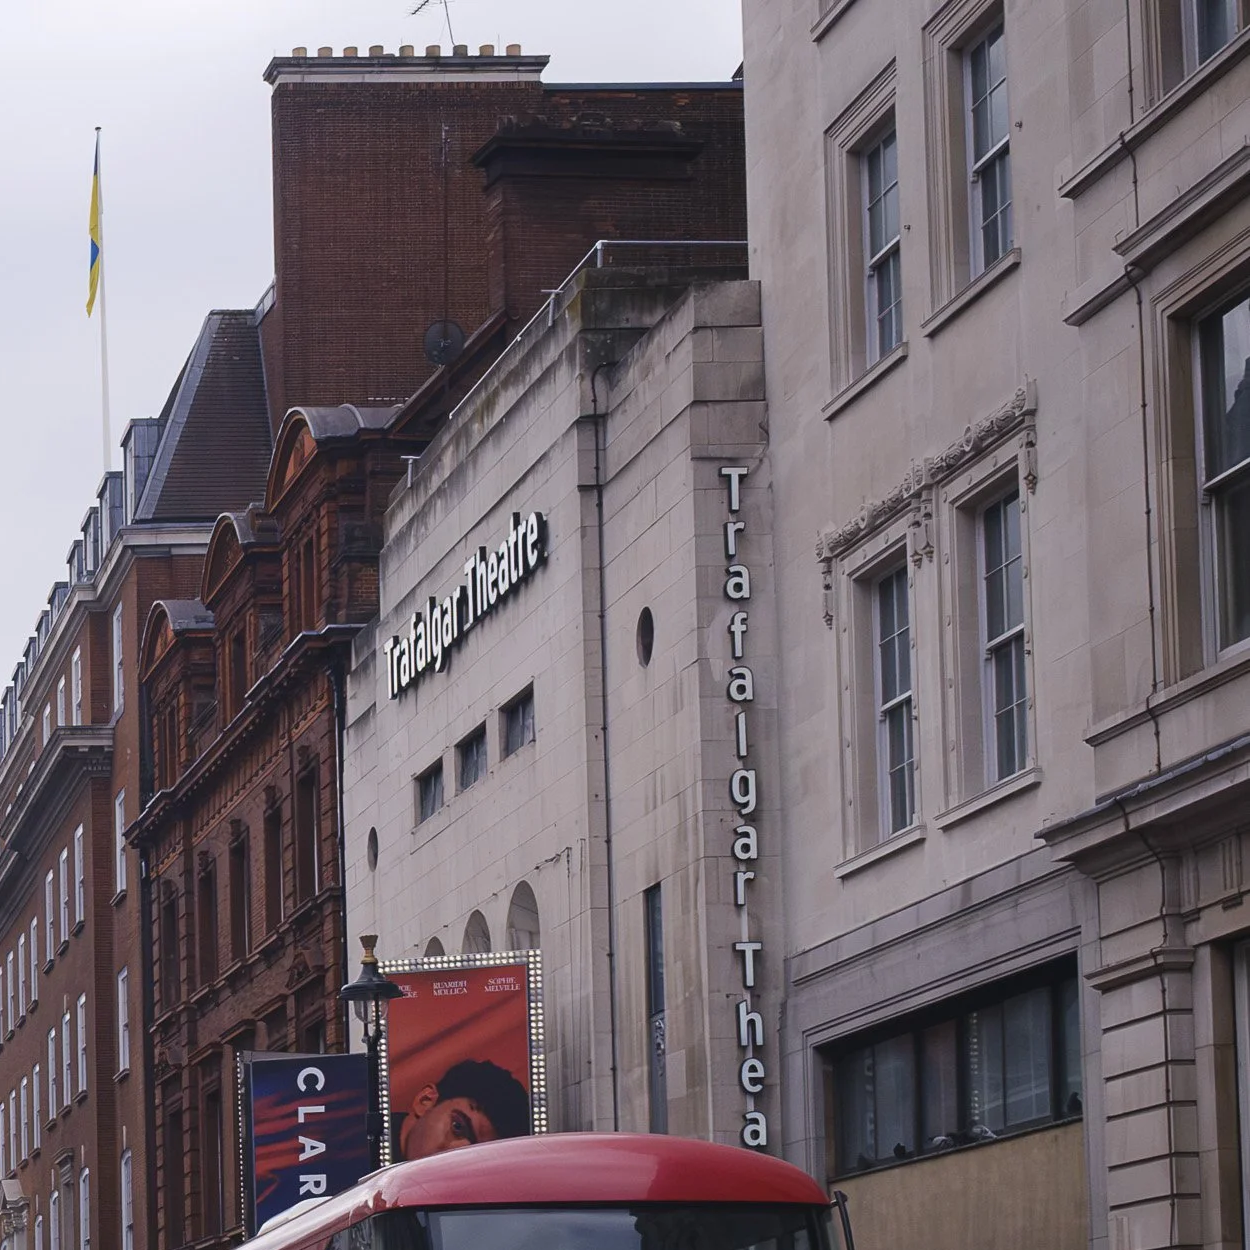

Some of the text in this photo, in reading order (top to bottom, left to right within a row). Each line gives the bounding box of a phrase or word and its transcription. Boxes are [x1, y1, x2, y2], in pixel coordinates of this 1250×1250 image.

[383, 511, 545, 700] Trafalgar Theatre
[720, 466, 759, 907] Trafalgar
